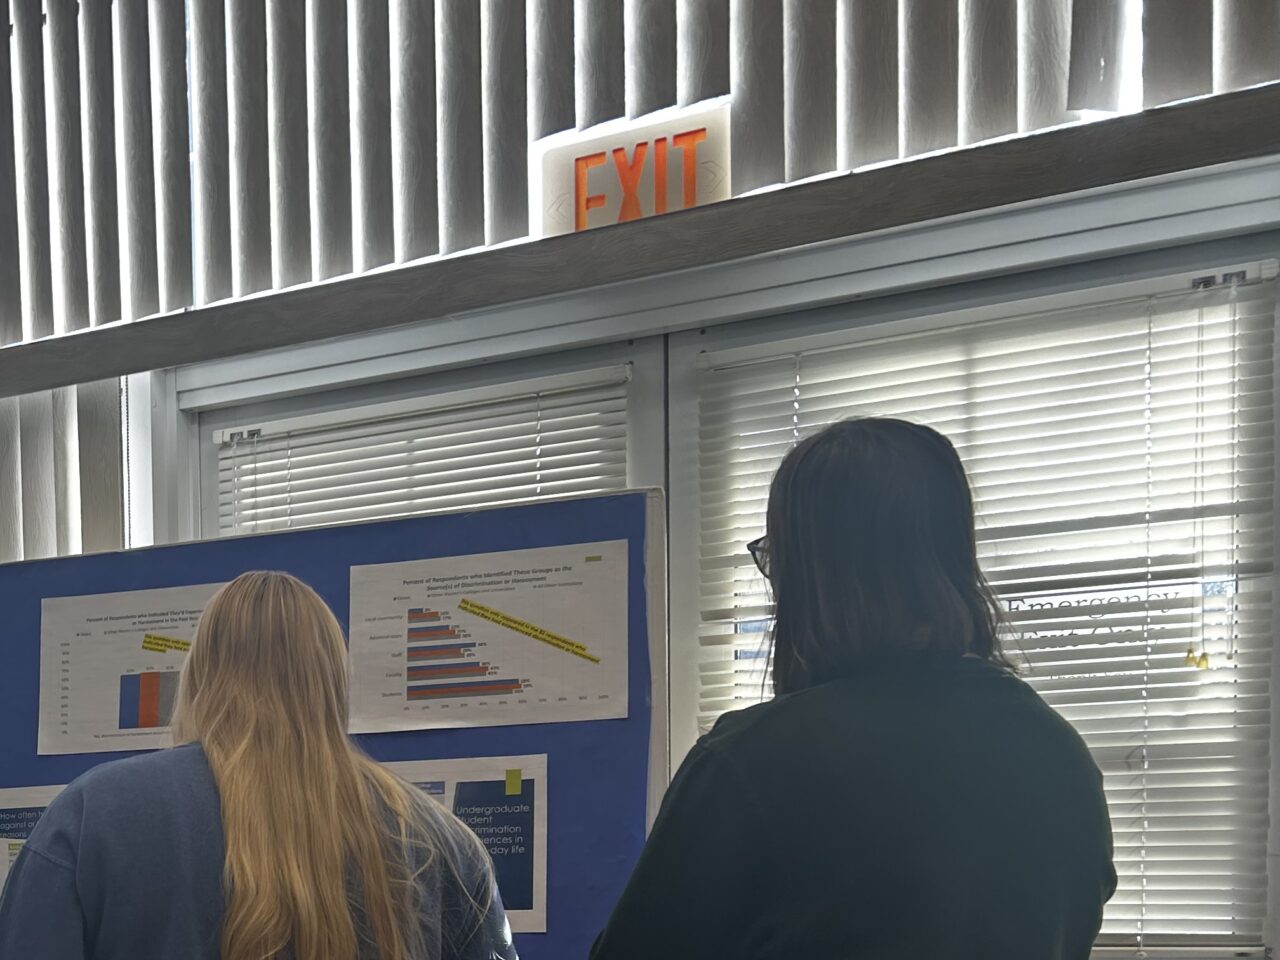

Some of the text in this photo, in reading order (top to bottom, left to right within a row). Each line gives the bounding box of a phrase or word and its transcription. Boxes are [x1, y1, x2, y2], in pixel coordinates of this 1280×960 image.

[575, 128, 706, 230] EXIT
[0, 811, 16, 820] How
[17, 810, 37, 820] often
[456, 804, 530, 816] Undergraduate
[459, 815, 493, 825] tudent
[0, 821, 27, 831] against
[473, 825, 522, 835] rimination
[480, 834, 524, 845] iences in
[510, 844, 526, 854] life
